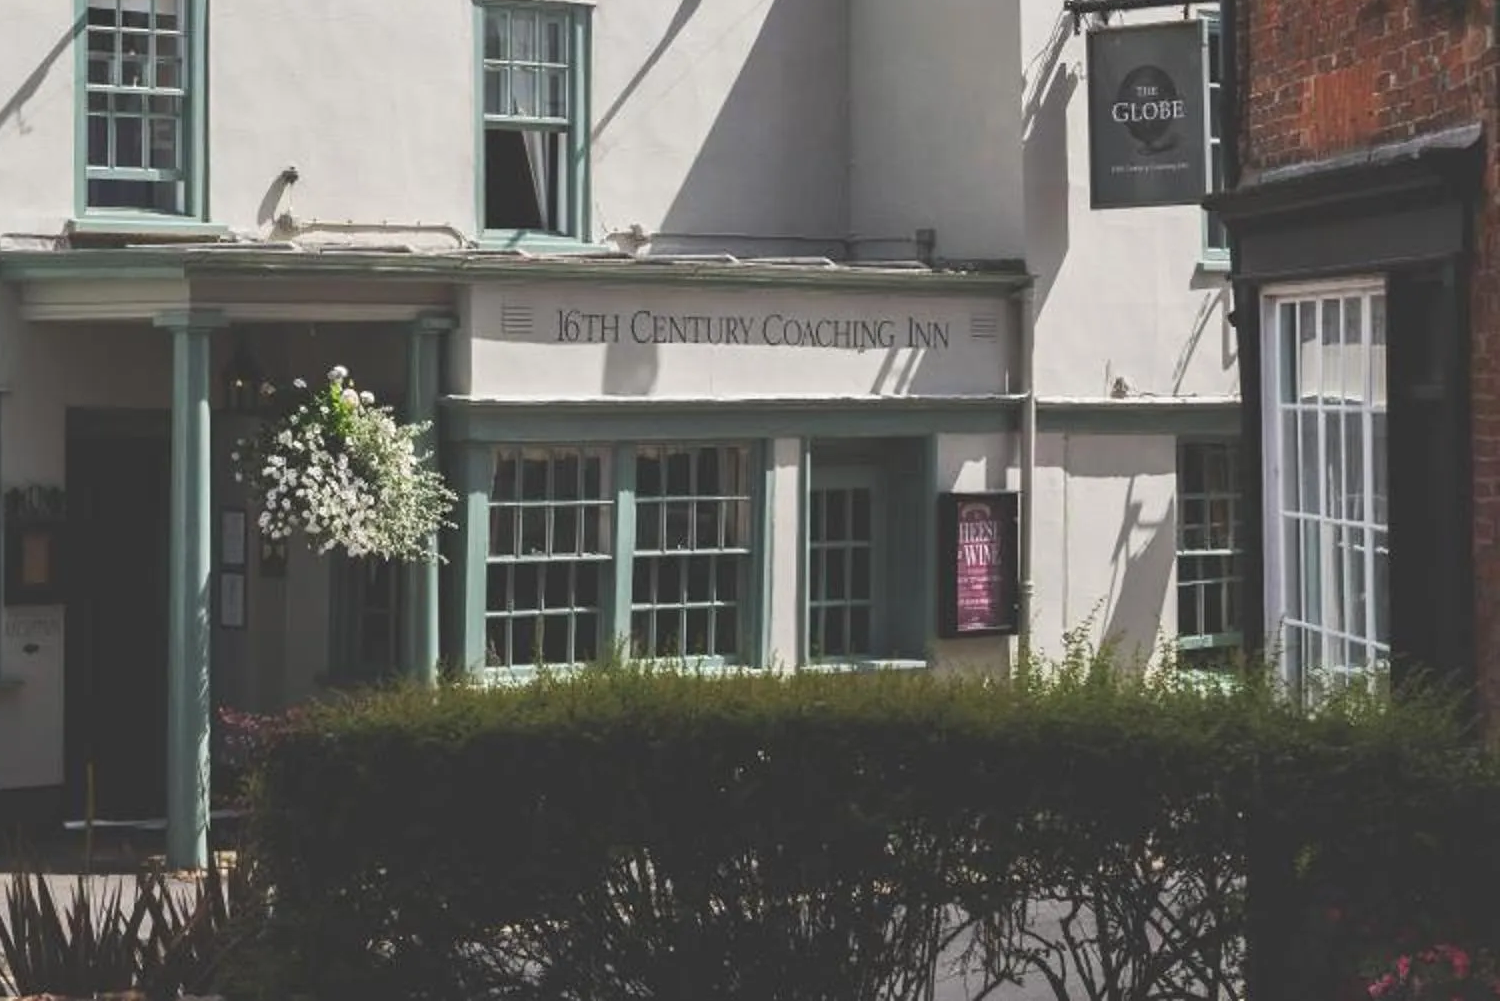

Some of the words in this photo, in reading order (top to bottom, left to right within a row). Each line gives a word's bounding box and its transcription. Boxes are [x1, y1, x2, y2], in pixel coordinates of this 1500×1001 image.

[1136, 86, 1159, 97] THE
[1112, 100, 1186, 122] GLOBE
[557, 309, 619, 342] 16TH
[631, 310, 754, 345] CENTURY
[762, 313, 896, 349] COACHING
[907, 316, 950, 349] INN
